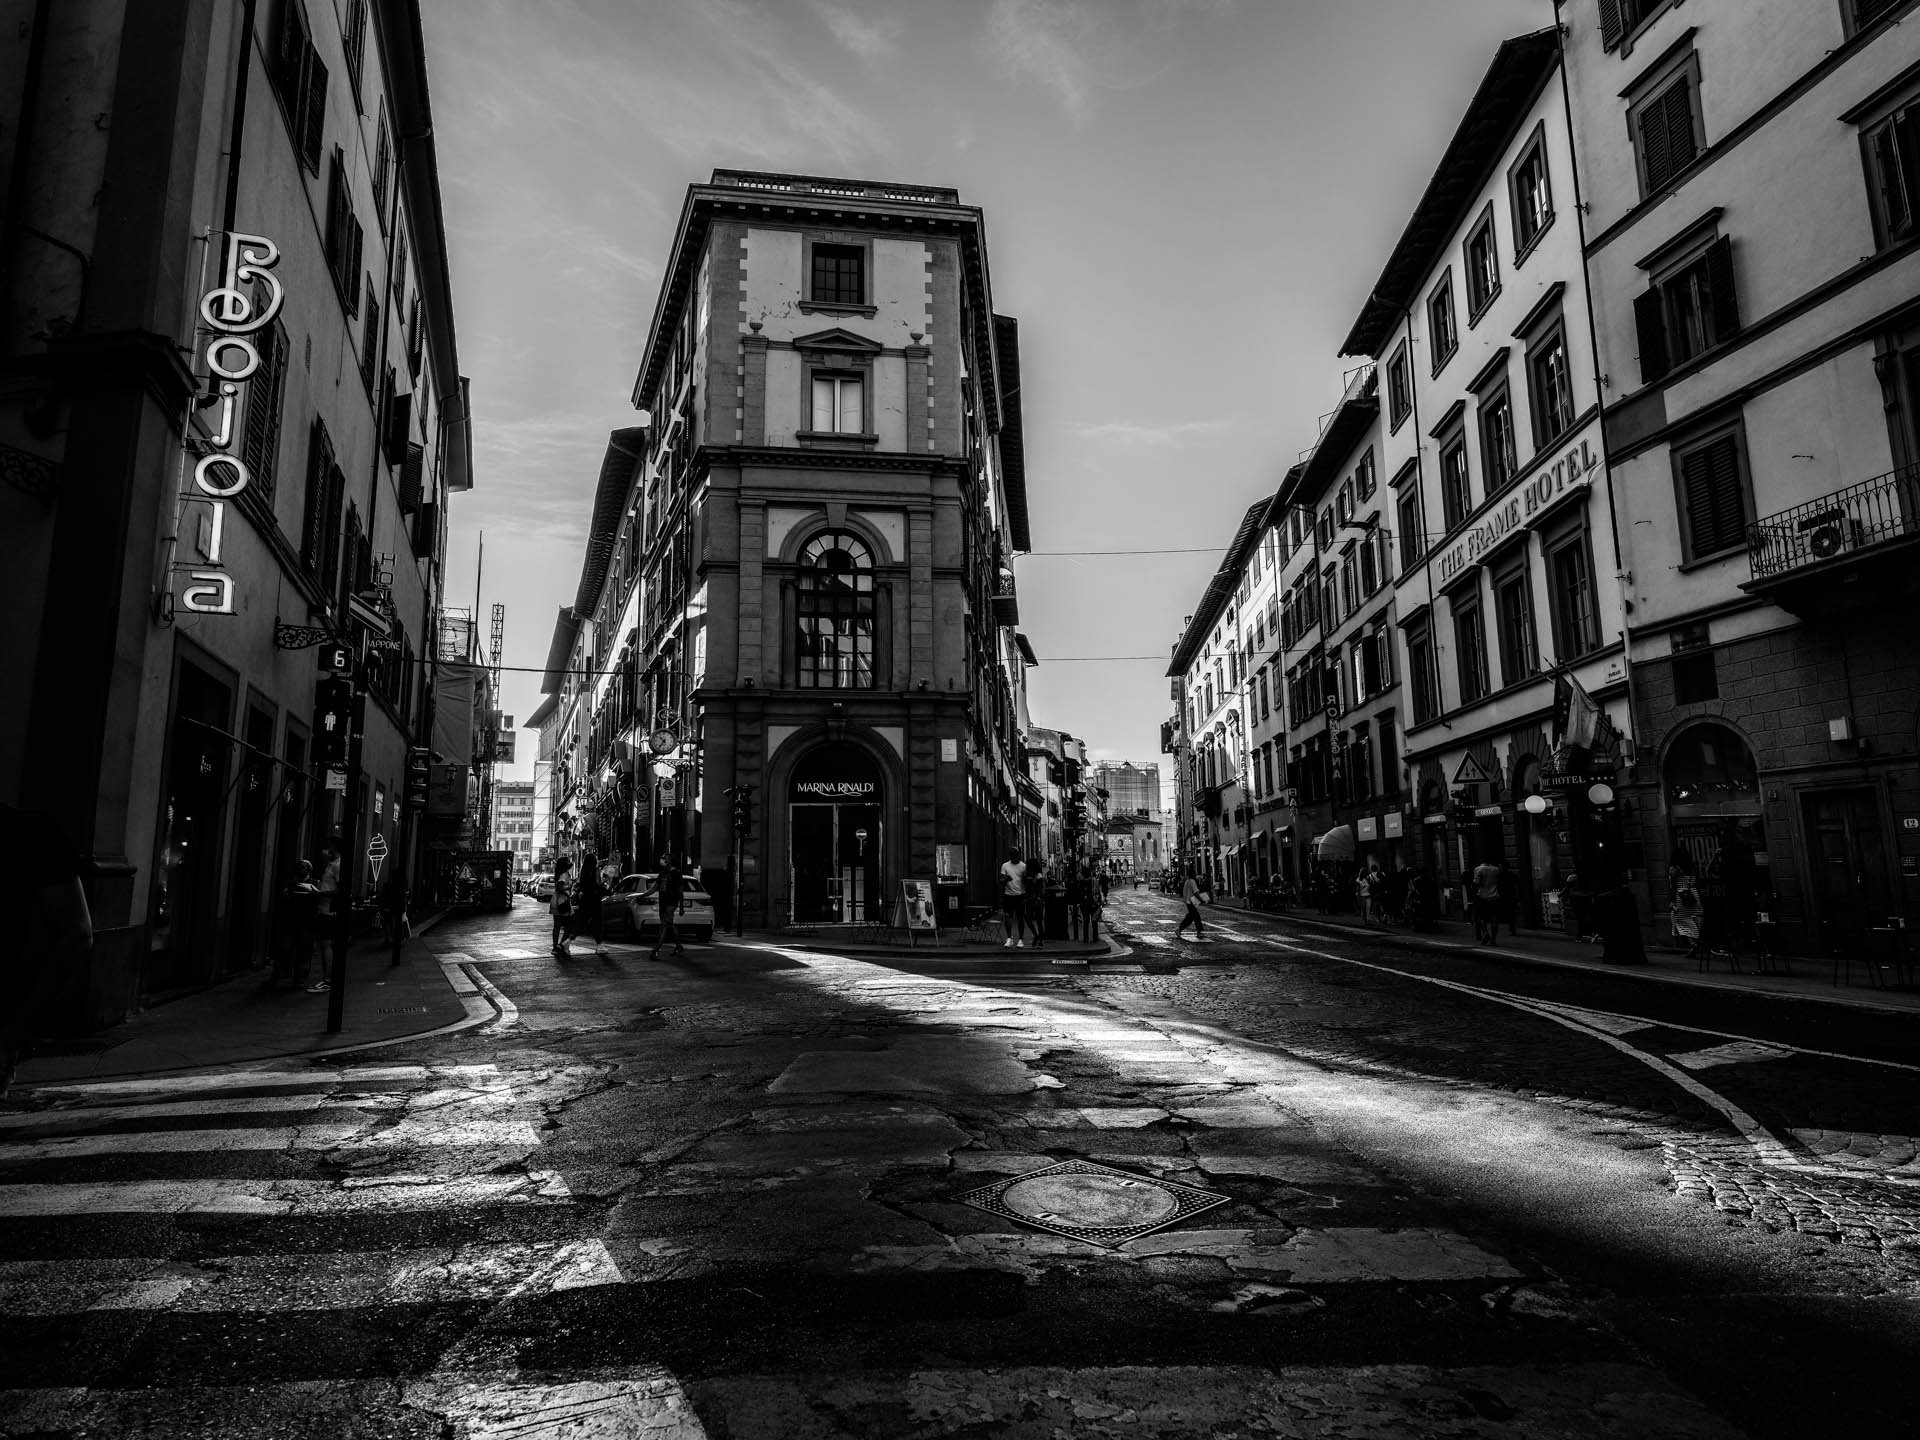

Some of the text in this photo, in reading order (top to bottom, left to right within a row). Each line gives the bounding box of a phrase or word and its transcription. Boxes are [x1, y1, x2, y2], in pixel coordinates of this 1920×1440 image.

[1438, 439, 1597, 582] THE FRAME HOTEL
[335, 650, 345, 667] 6
[797, 782, 875, 795] MARINA RINALDI
